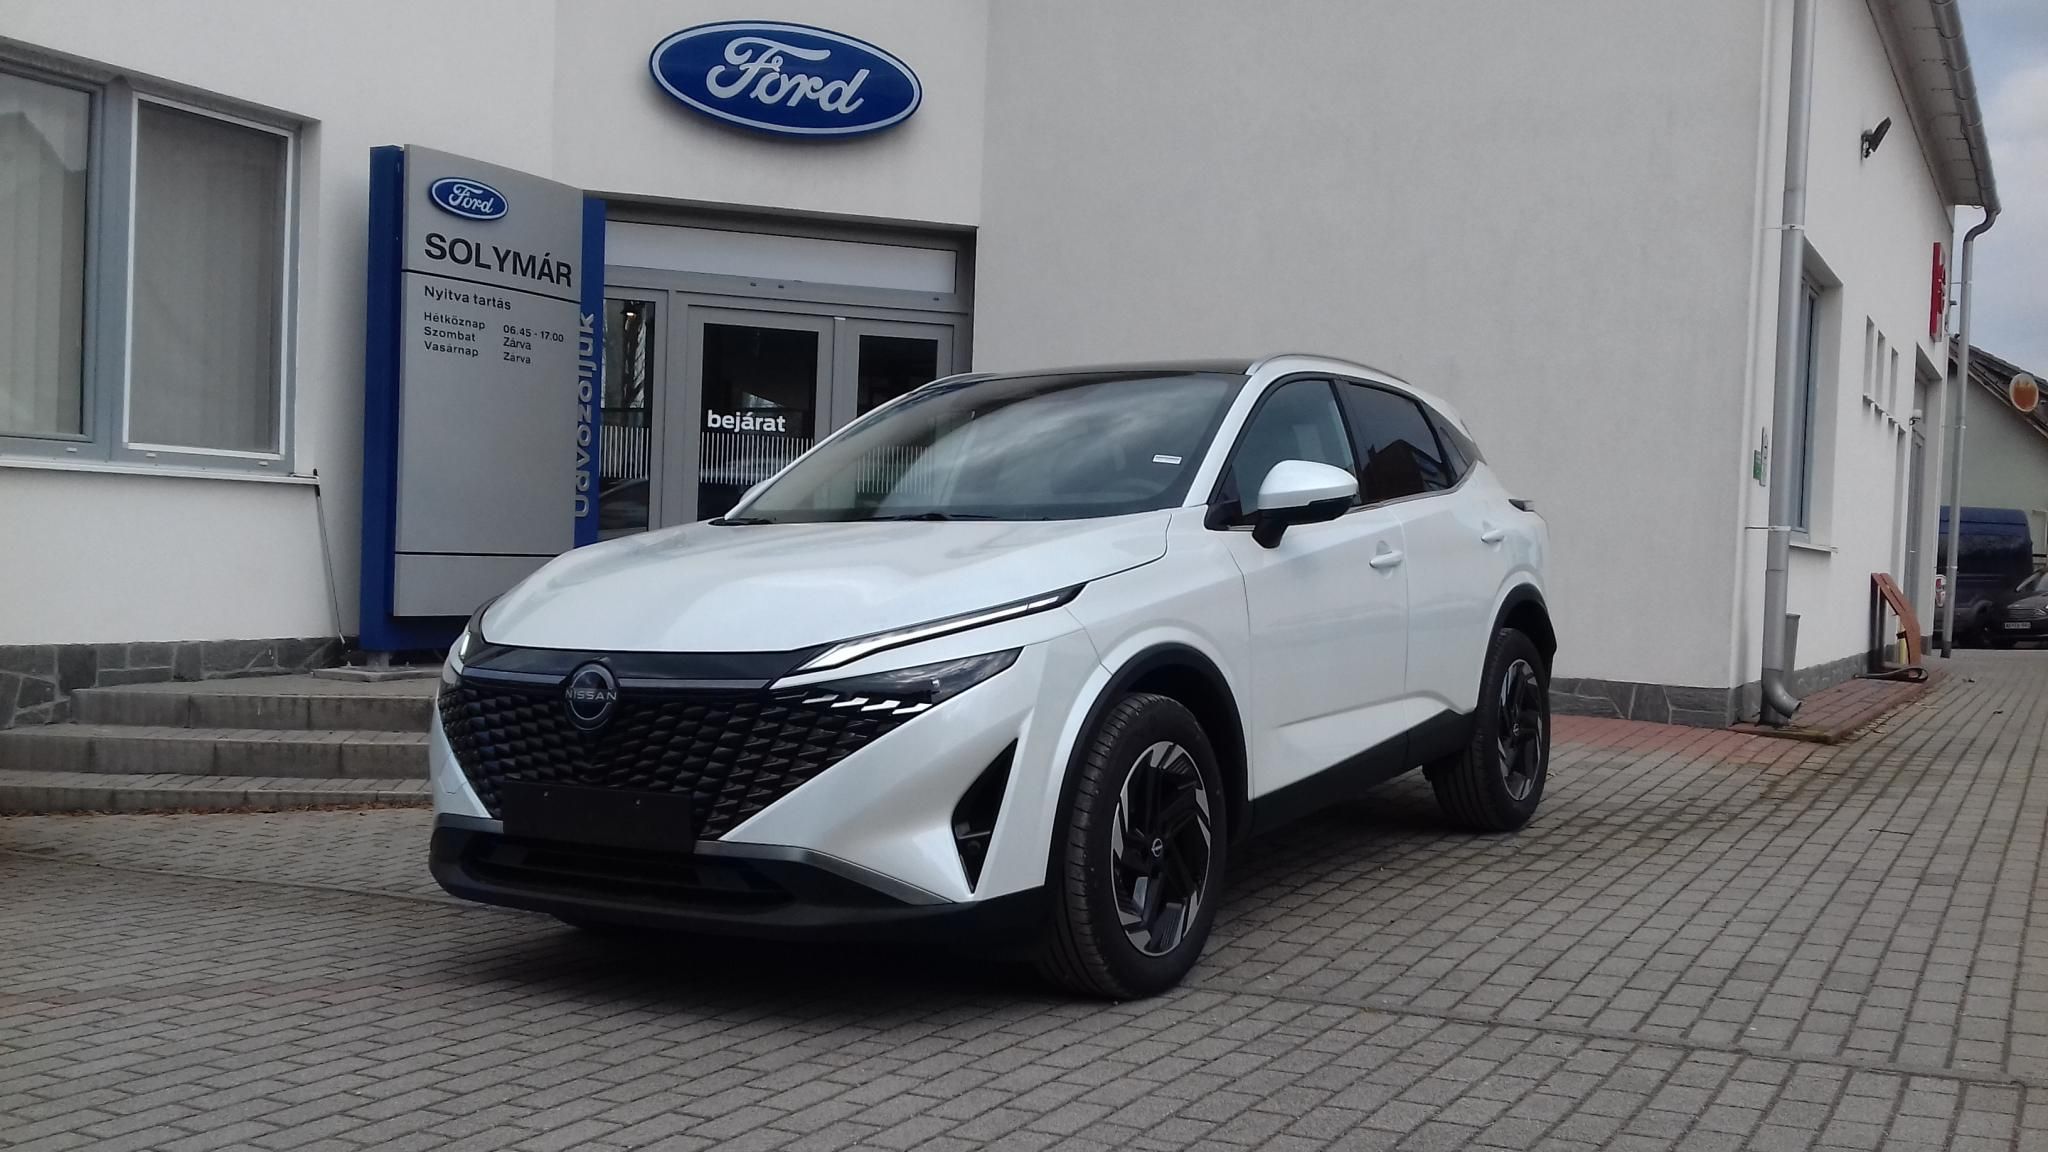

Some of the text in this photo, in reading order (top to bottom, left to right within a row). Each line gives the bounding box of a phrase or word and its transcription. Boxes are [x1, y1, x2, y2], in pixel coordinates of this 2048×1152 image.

[706, 36, 870, 114] Ford
[448, 183, 494, 215] Ford
[424, 232, 572, 288] SOLYMÁR
[424, 285, 511, 311] Nyitva tartás
[424, 312, 486, 330] Hétköznap
[424, 327, 531, 350] Szombat Zárva
[424, 341, 479, 358] Vasárnap
[707, 409, 786, 433] bejárat
[565, 689, 617, 701] NISSAN
